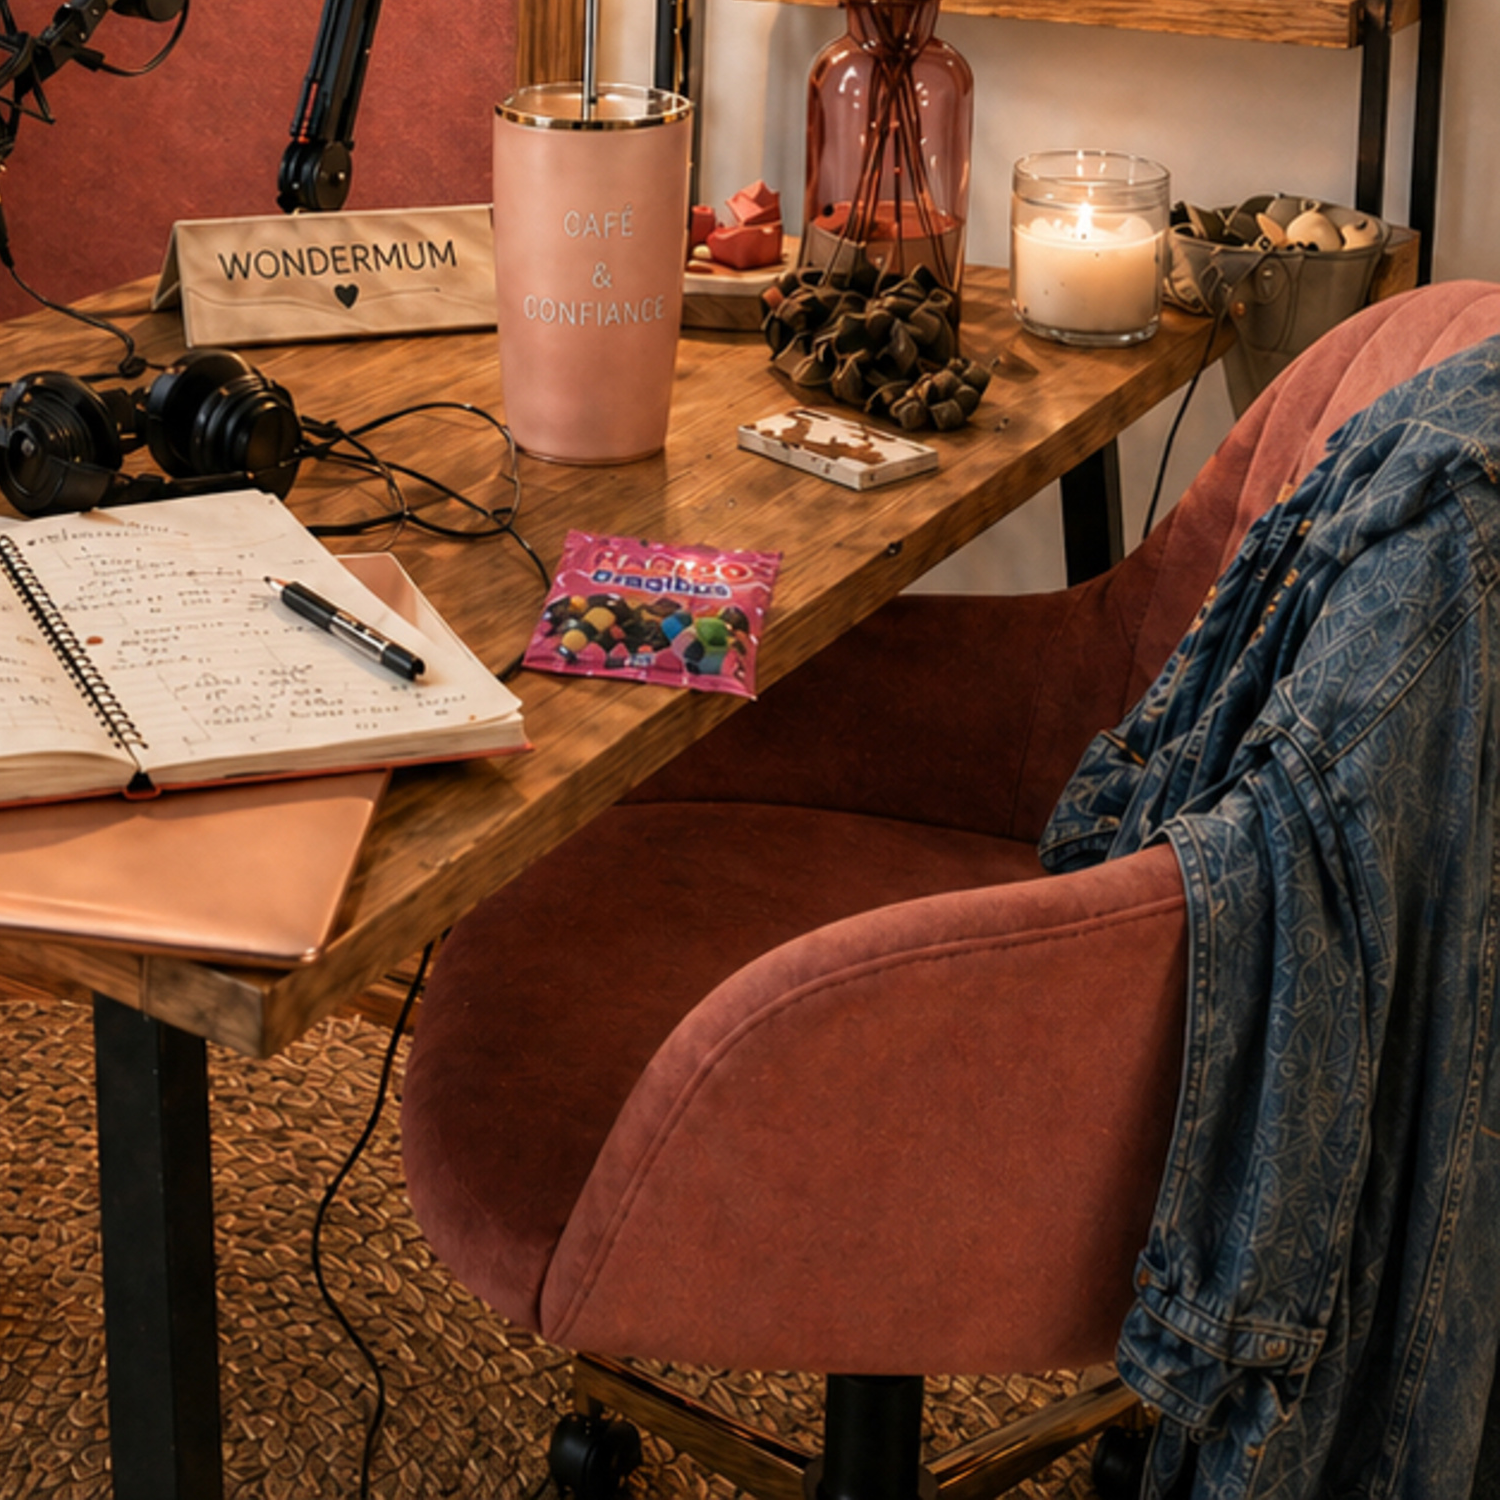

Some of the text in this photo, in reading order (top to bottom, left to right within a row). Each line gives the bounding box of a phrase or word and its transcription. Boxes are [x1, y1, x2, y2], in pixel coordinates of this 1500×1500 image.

[563, 204, 634, 239] CAFÉ
[218, 239, 458, 281] WONDERMUM
[591, 261, 613, 289] &
[523, 294, 665, 326] CONFIANCE
